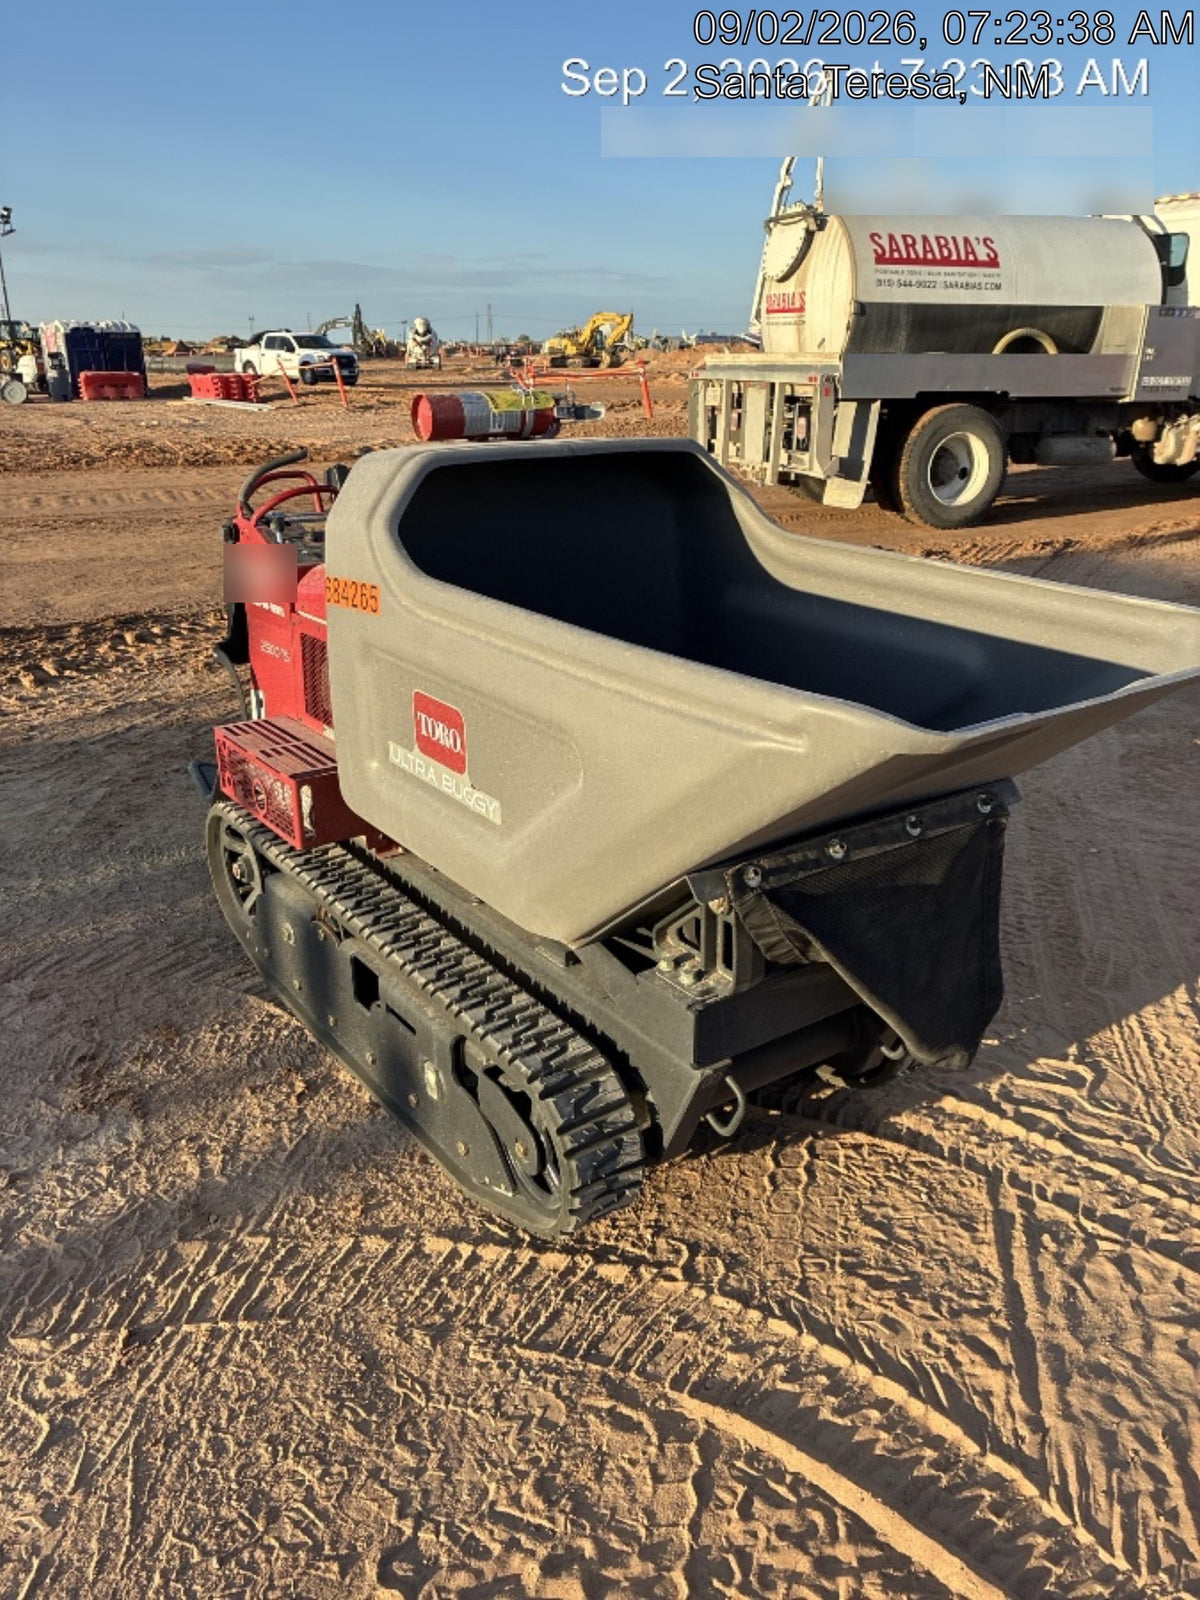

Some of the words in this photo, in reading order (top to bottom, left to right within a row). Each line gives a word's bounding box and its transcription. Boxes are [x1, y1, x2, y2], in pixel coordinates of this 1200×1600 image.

[869, 231, 999, 263] SARABIA'S
[416, 711, 462, 753] TORO
[389, 741, 439, 788] ULTRA
[441, 772, 498, 821] BUGGY
